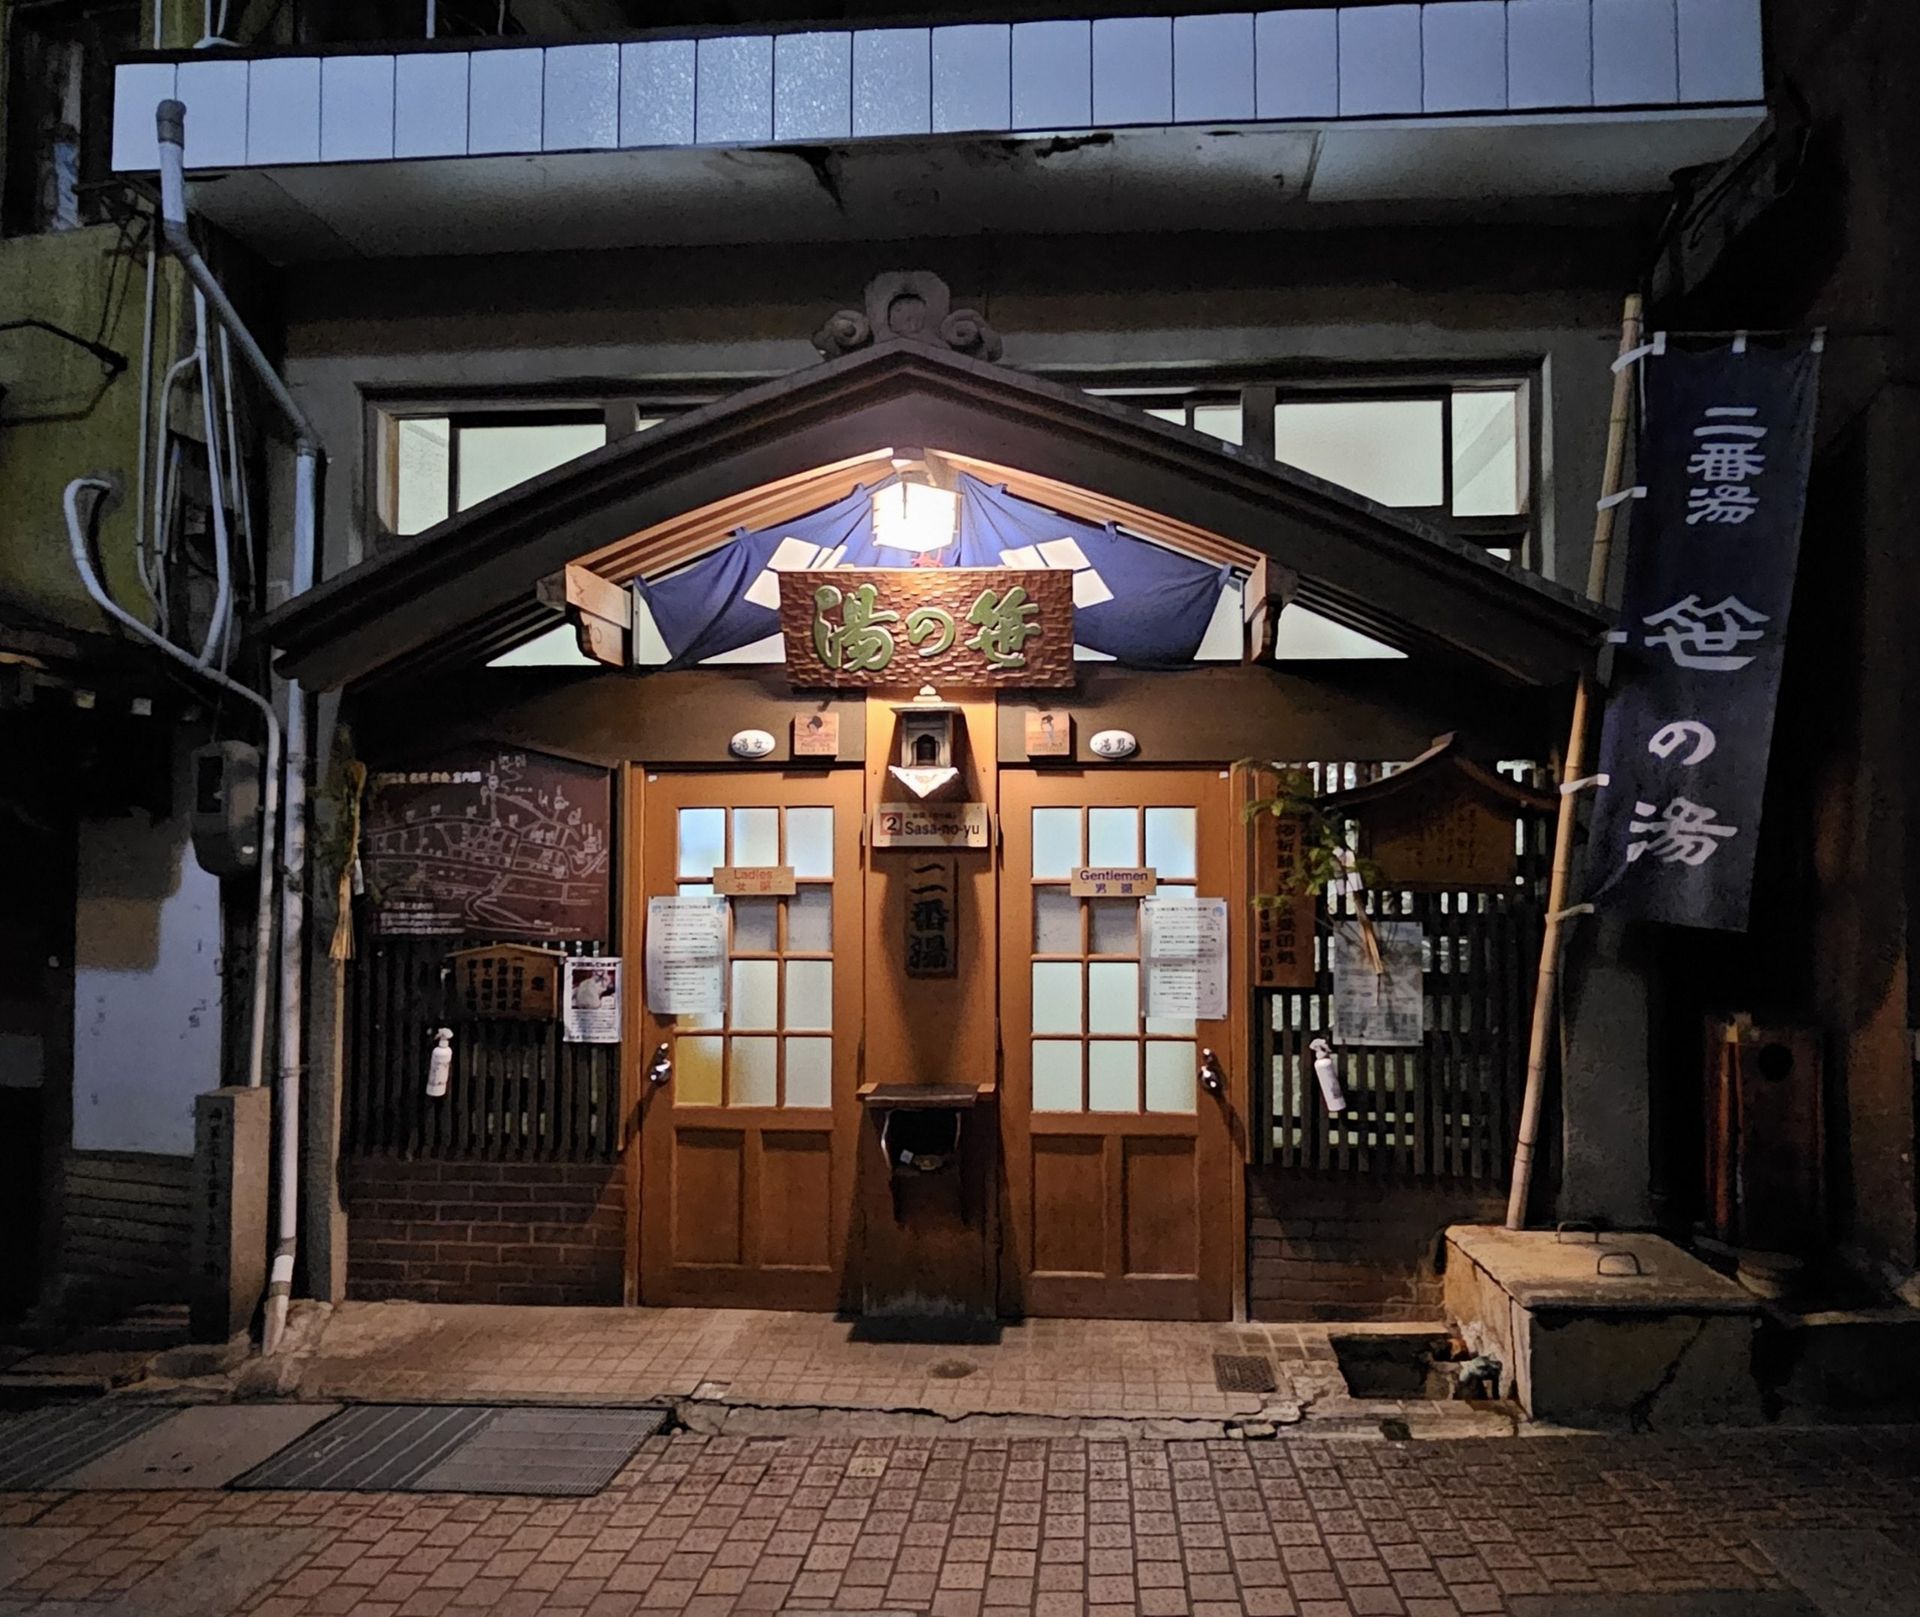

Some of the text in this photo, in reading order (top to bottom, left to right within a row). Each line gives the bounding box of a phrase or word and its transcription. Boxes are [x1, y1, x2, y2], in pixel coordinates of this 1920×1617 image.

[1628, 406, 1771, 866] 二番湯 笹の湯
[886, 816, 897, 831] 2
[905, 821, 980, 839] Sasa-no-yu
[734, 868, 773, 880] Ladies
[1080, 870, 1149, 882] Gentlemen
[909, 862, 949, 969] 二番湯
